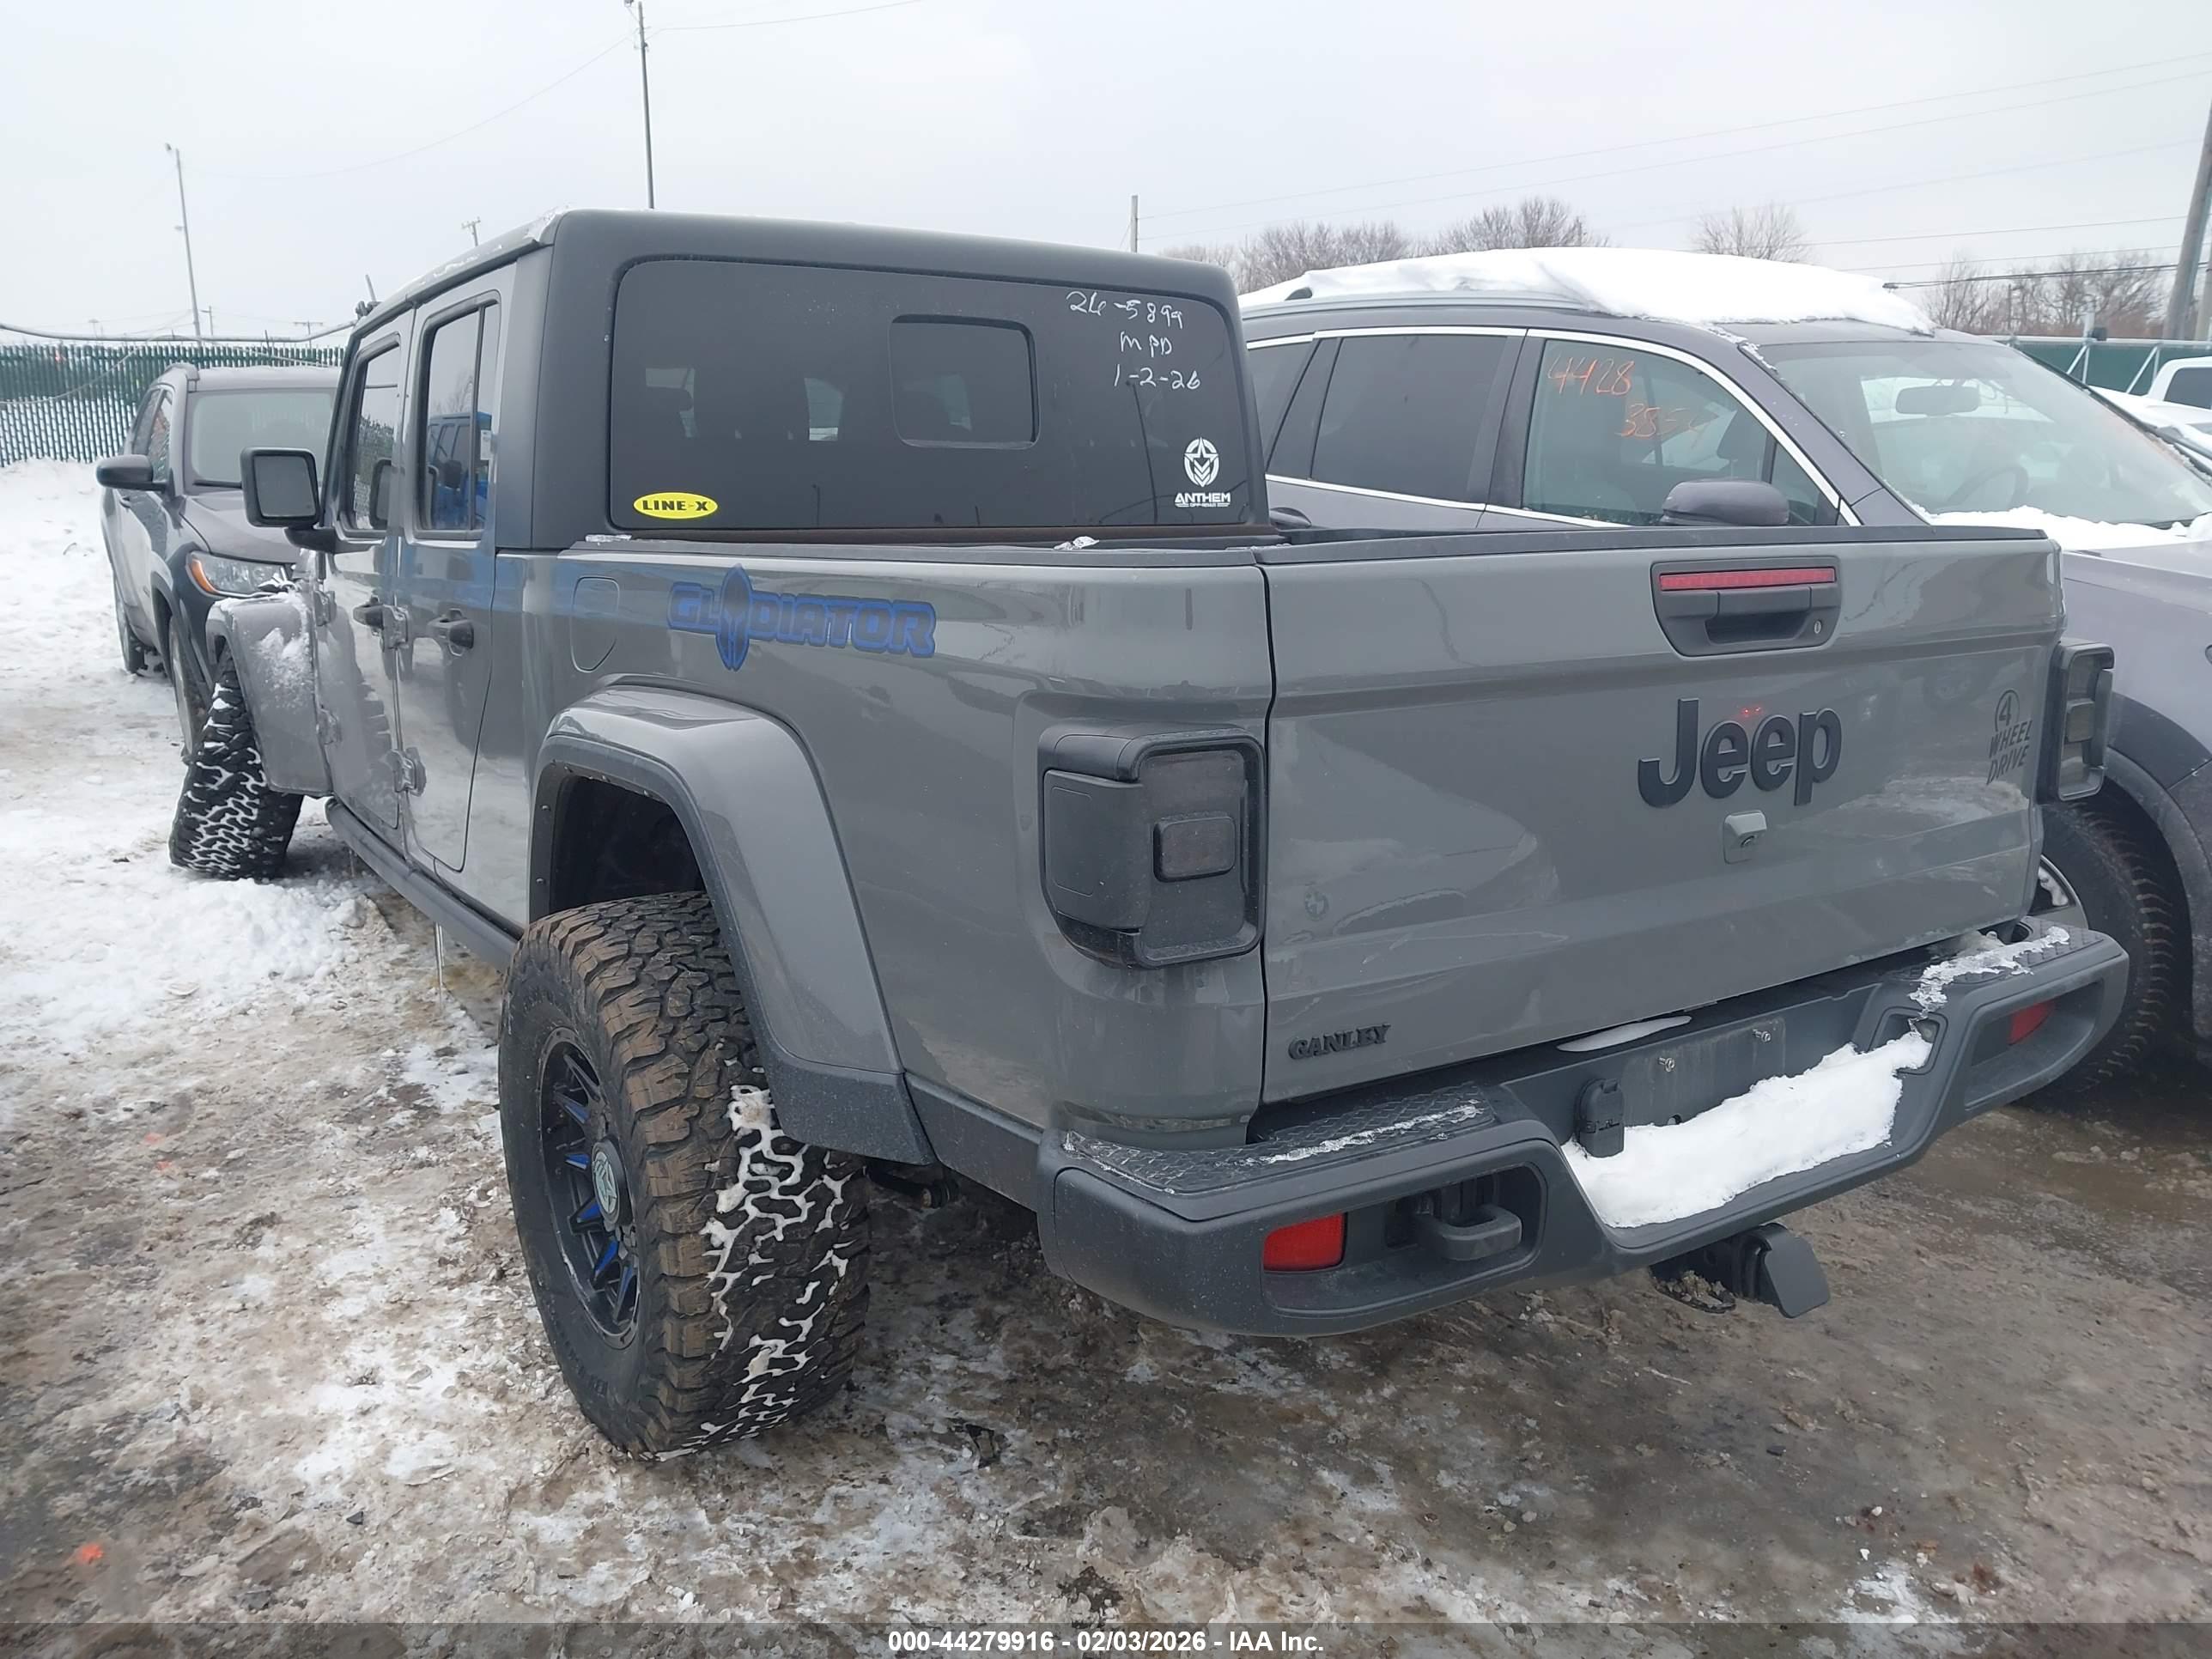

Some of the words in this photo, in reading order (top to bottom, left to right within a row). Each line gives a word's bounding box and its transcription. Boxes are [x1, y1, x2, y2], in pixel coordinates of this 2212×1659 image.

[1114, 363, 1200, 390] 1-2-26
[1547, 354, 1635, 396] 4428
[642, 500, 708, 511] LINE-X
[1174, 492, 1231, 504] ANTHEM
[1638, 698, 1843, 808] Jeep
[1989, 720, 2033, 759] WHEEL
[1986, 744, 2029, 785] DRIVE
[1288, 1023, 1391, 1060] GANLEY
